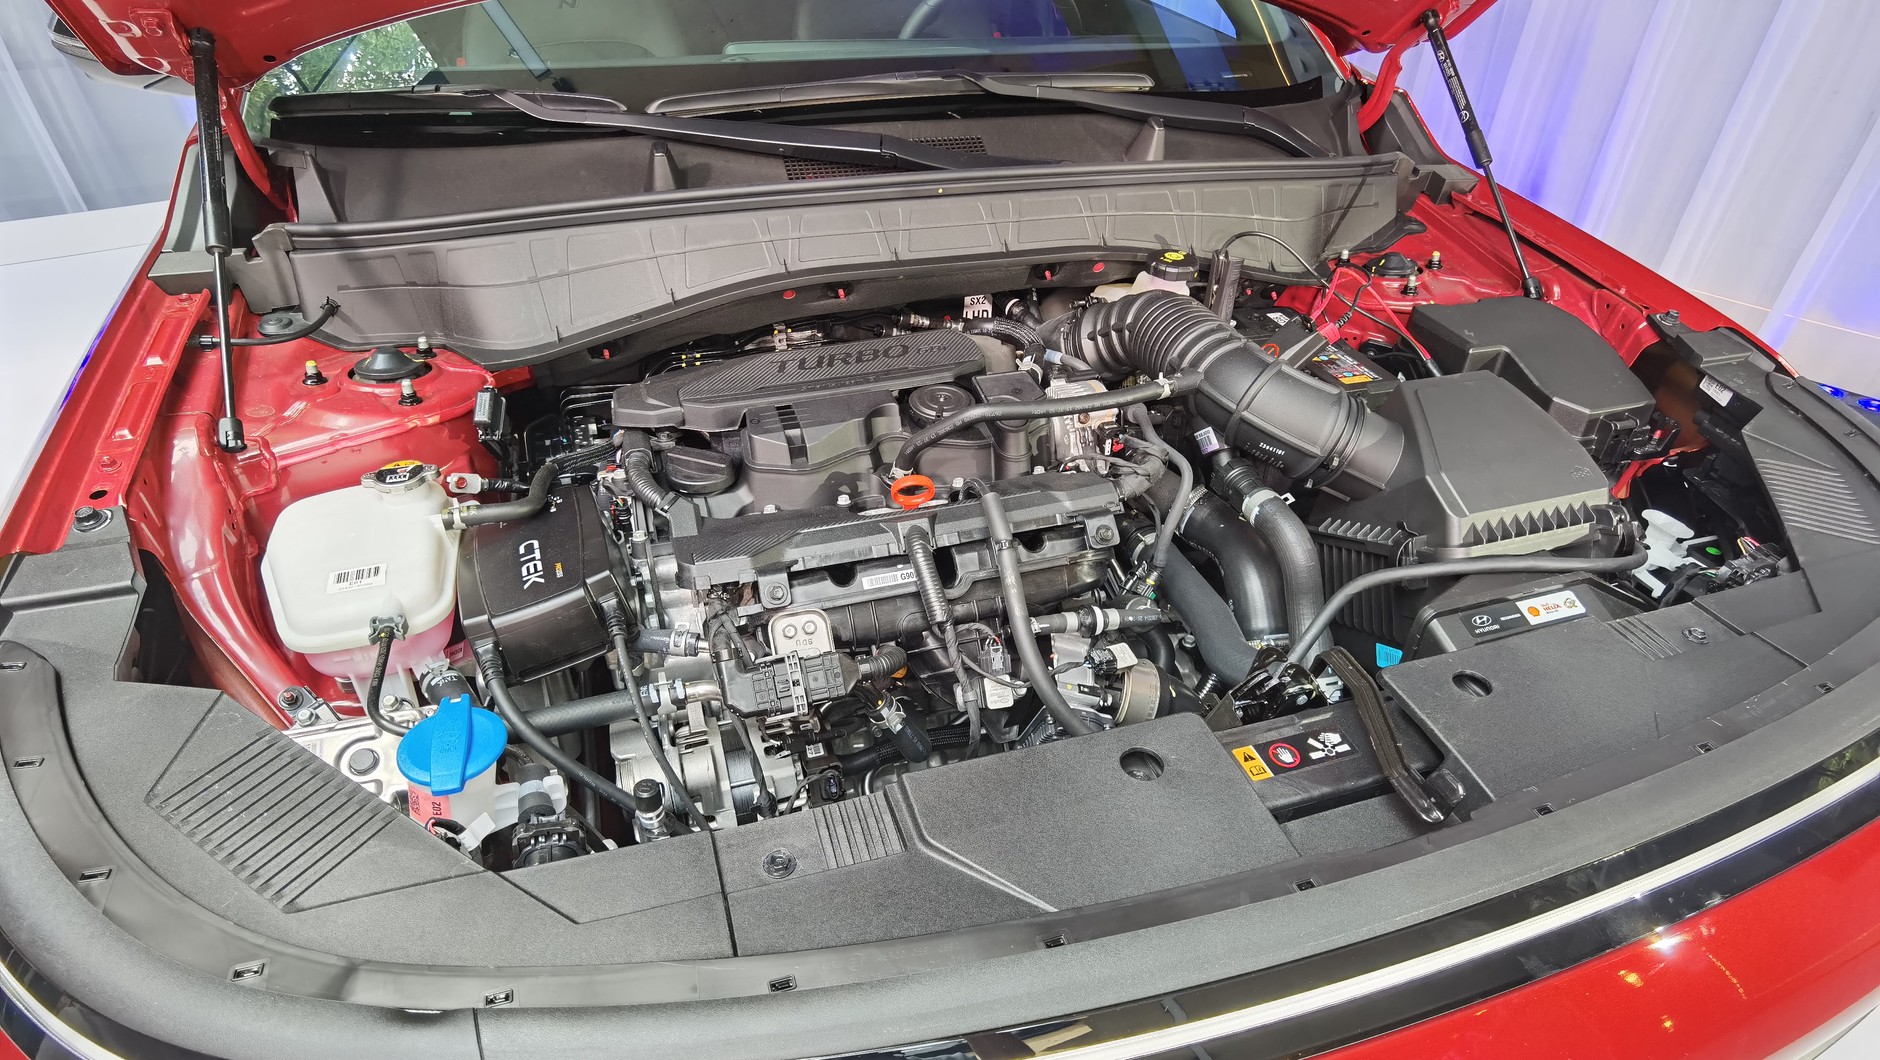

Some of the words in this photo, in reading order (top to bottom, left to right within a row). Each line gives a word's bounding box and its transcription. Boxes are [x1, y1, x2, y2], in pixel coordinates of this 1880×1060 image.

[970, 296, 987, 306] SX2
[771, 344, 909, 374] TURBO
[519, 540, 545, 590] CTEK
[1475, 624, 1500, 634] HYUNDAI
[432, 801, 442, 816] E02
